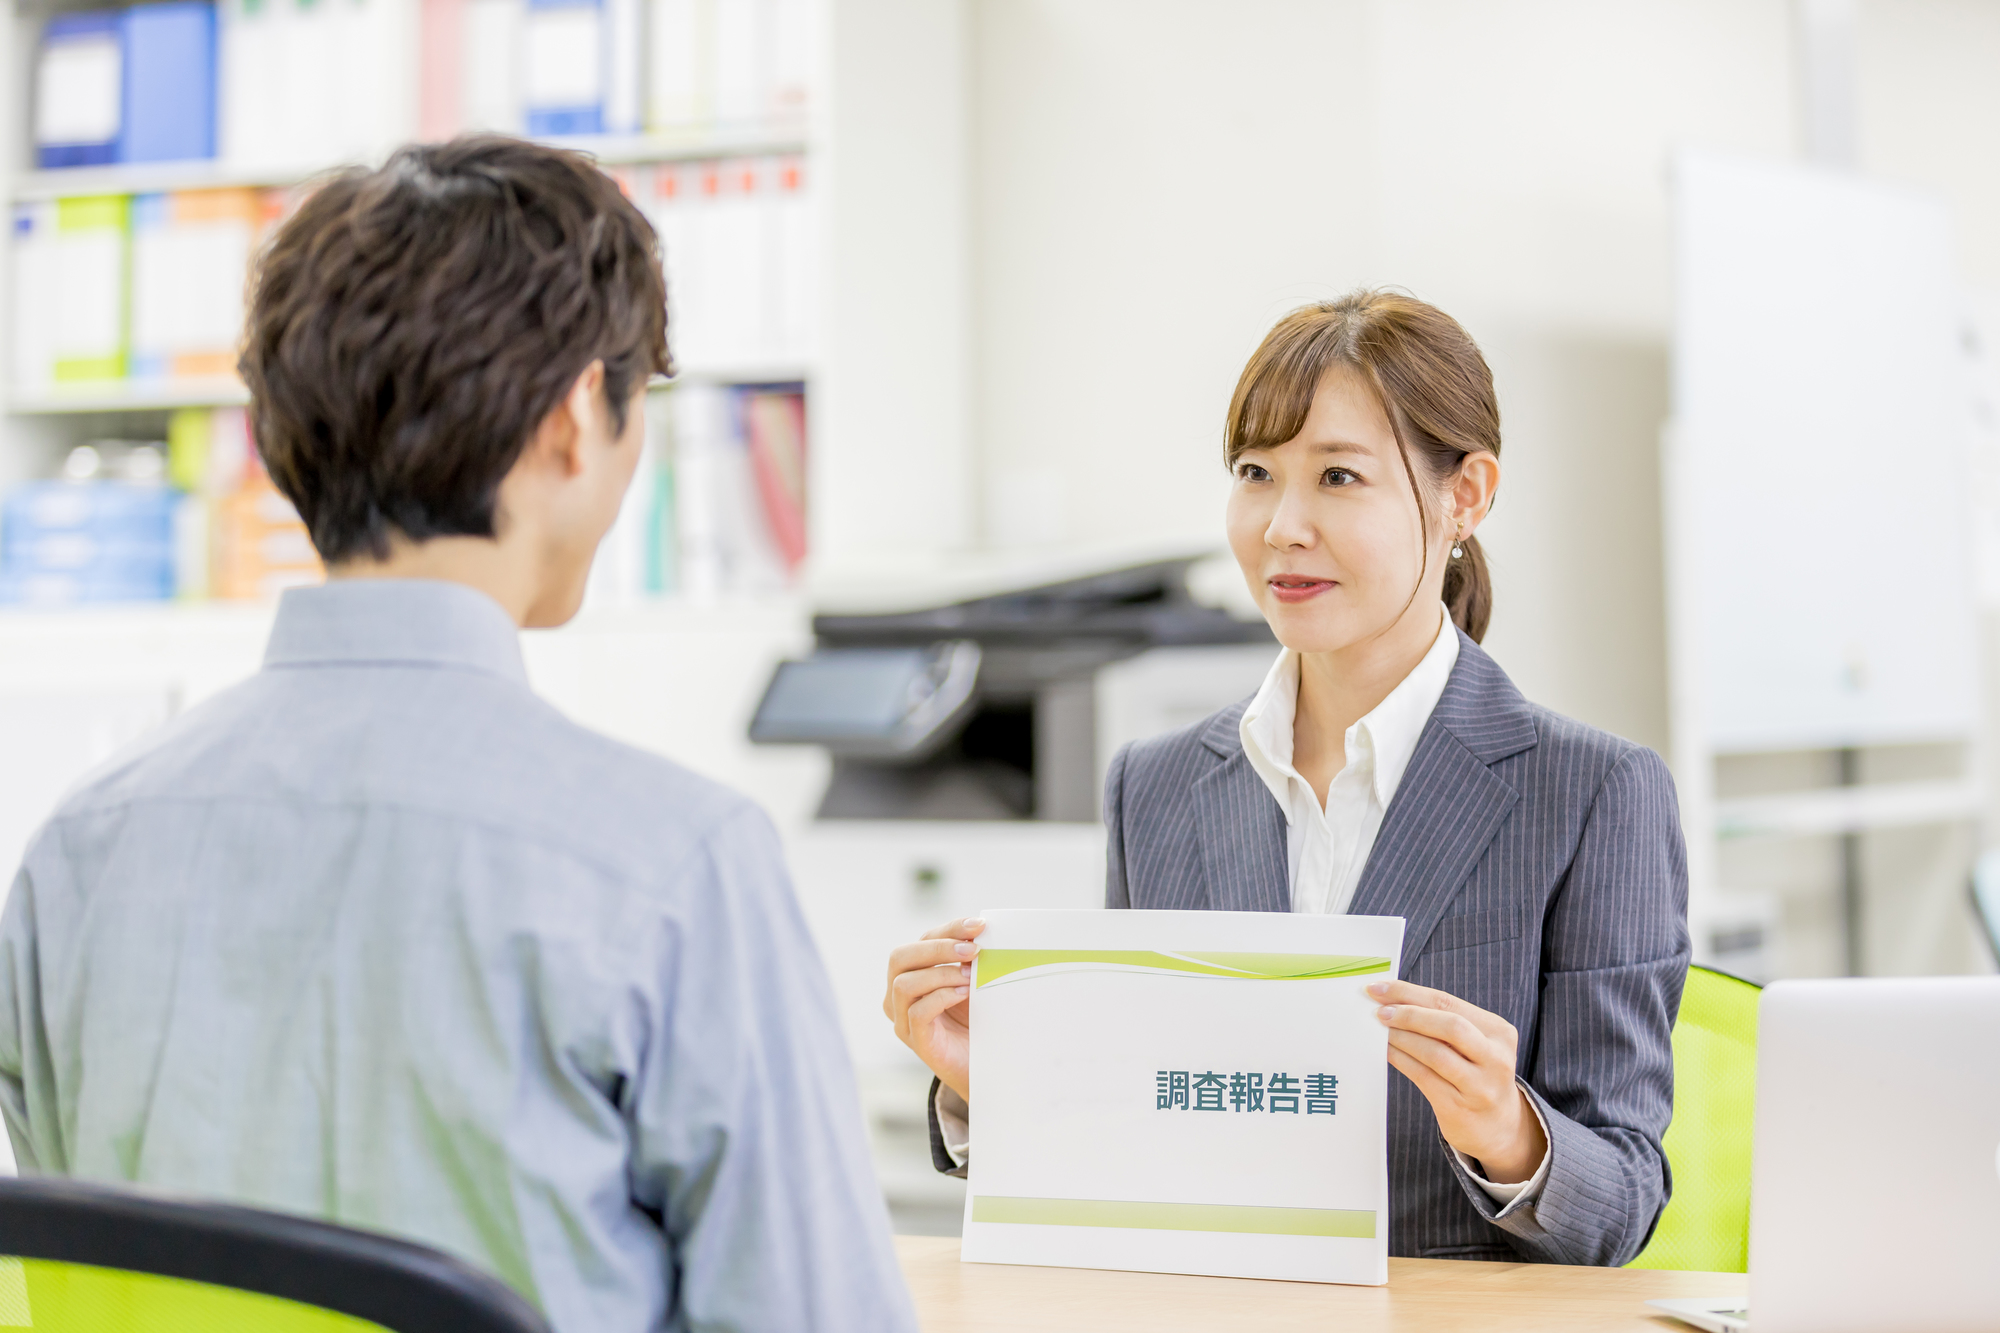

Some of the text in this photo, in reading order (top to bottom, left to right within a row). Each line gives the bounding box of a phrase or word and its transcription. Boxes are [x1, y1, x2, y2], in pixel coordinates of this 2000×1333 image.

[1155, 1070, 1339, 1115] 調査報告書
